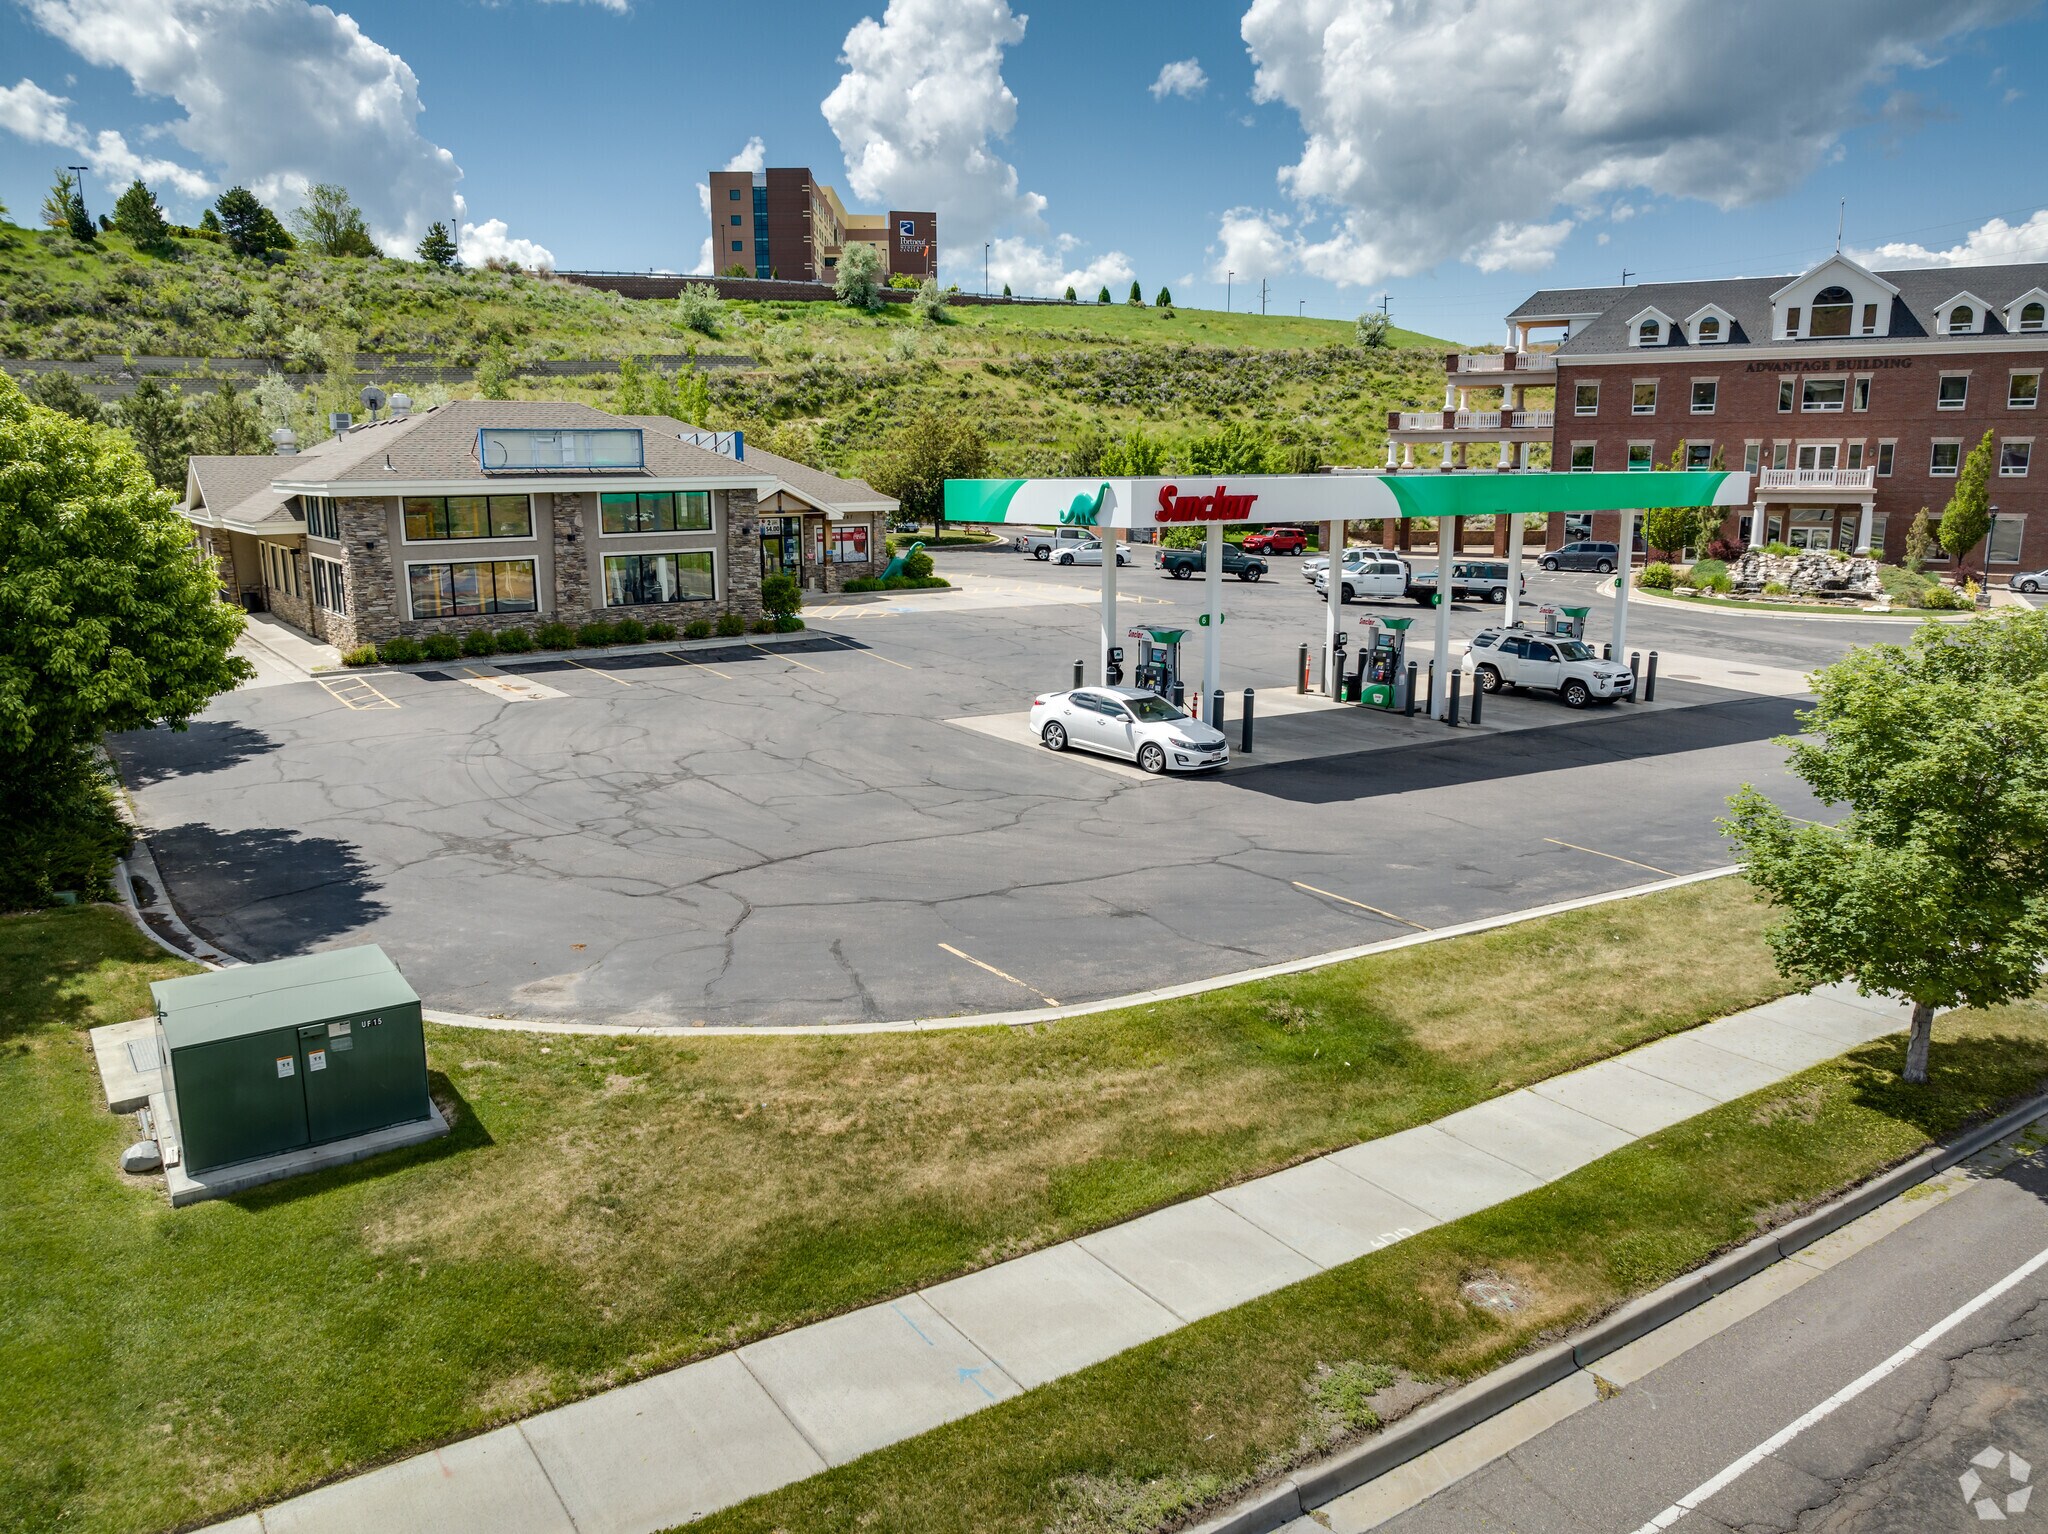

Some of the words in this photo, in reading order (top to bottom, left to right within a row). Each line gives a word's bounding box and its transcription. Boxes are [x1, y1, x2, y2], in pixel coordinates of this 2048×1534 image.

[1745, 361, 1830, 373] ADVANTAGE
[1835, 358, 1912, 370] BUILDING
[1155, 484, 1259, 522] Sinclair
